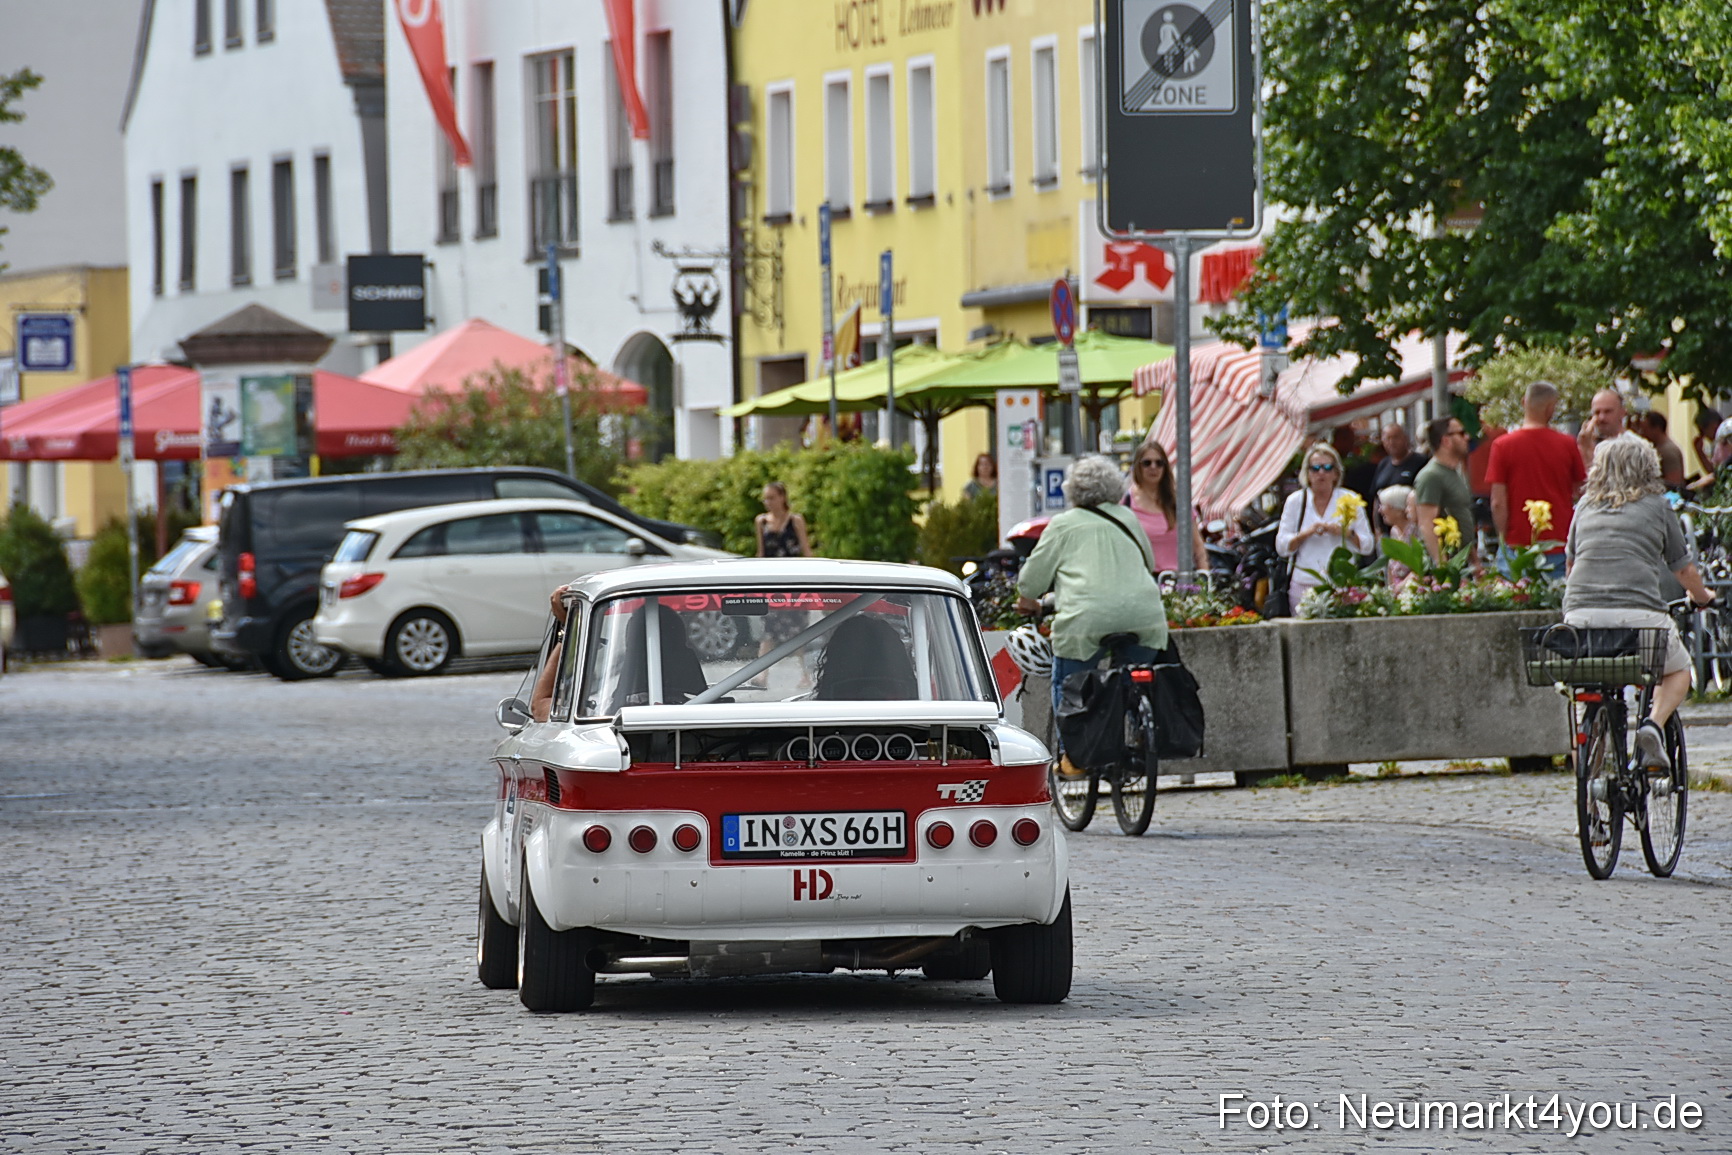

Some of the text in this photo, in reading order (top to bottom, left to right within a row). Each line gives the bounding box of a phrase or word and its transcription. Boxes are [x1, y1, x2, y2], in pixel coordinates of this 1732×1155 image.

[835, 0, 886, 52] HOTEL
[1150, 86, 1207, 105] ZONE
[1049, 472, 1063, 494] P
[728, 838, 735, 846] D
[744, 816, 901, 847] IN XS 66H
[794, 869, 834, 901] HD
